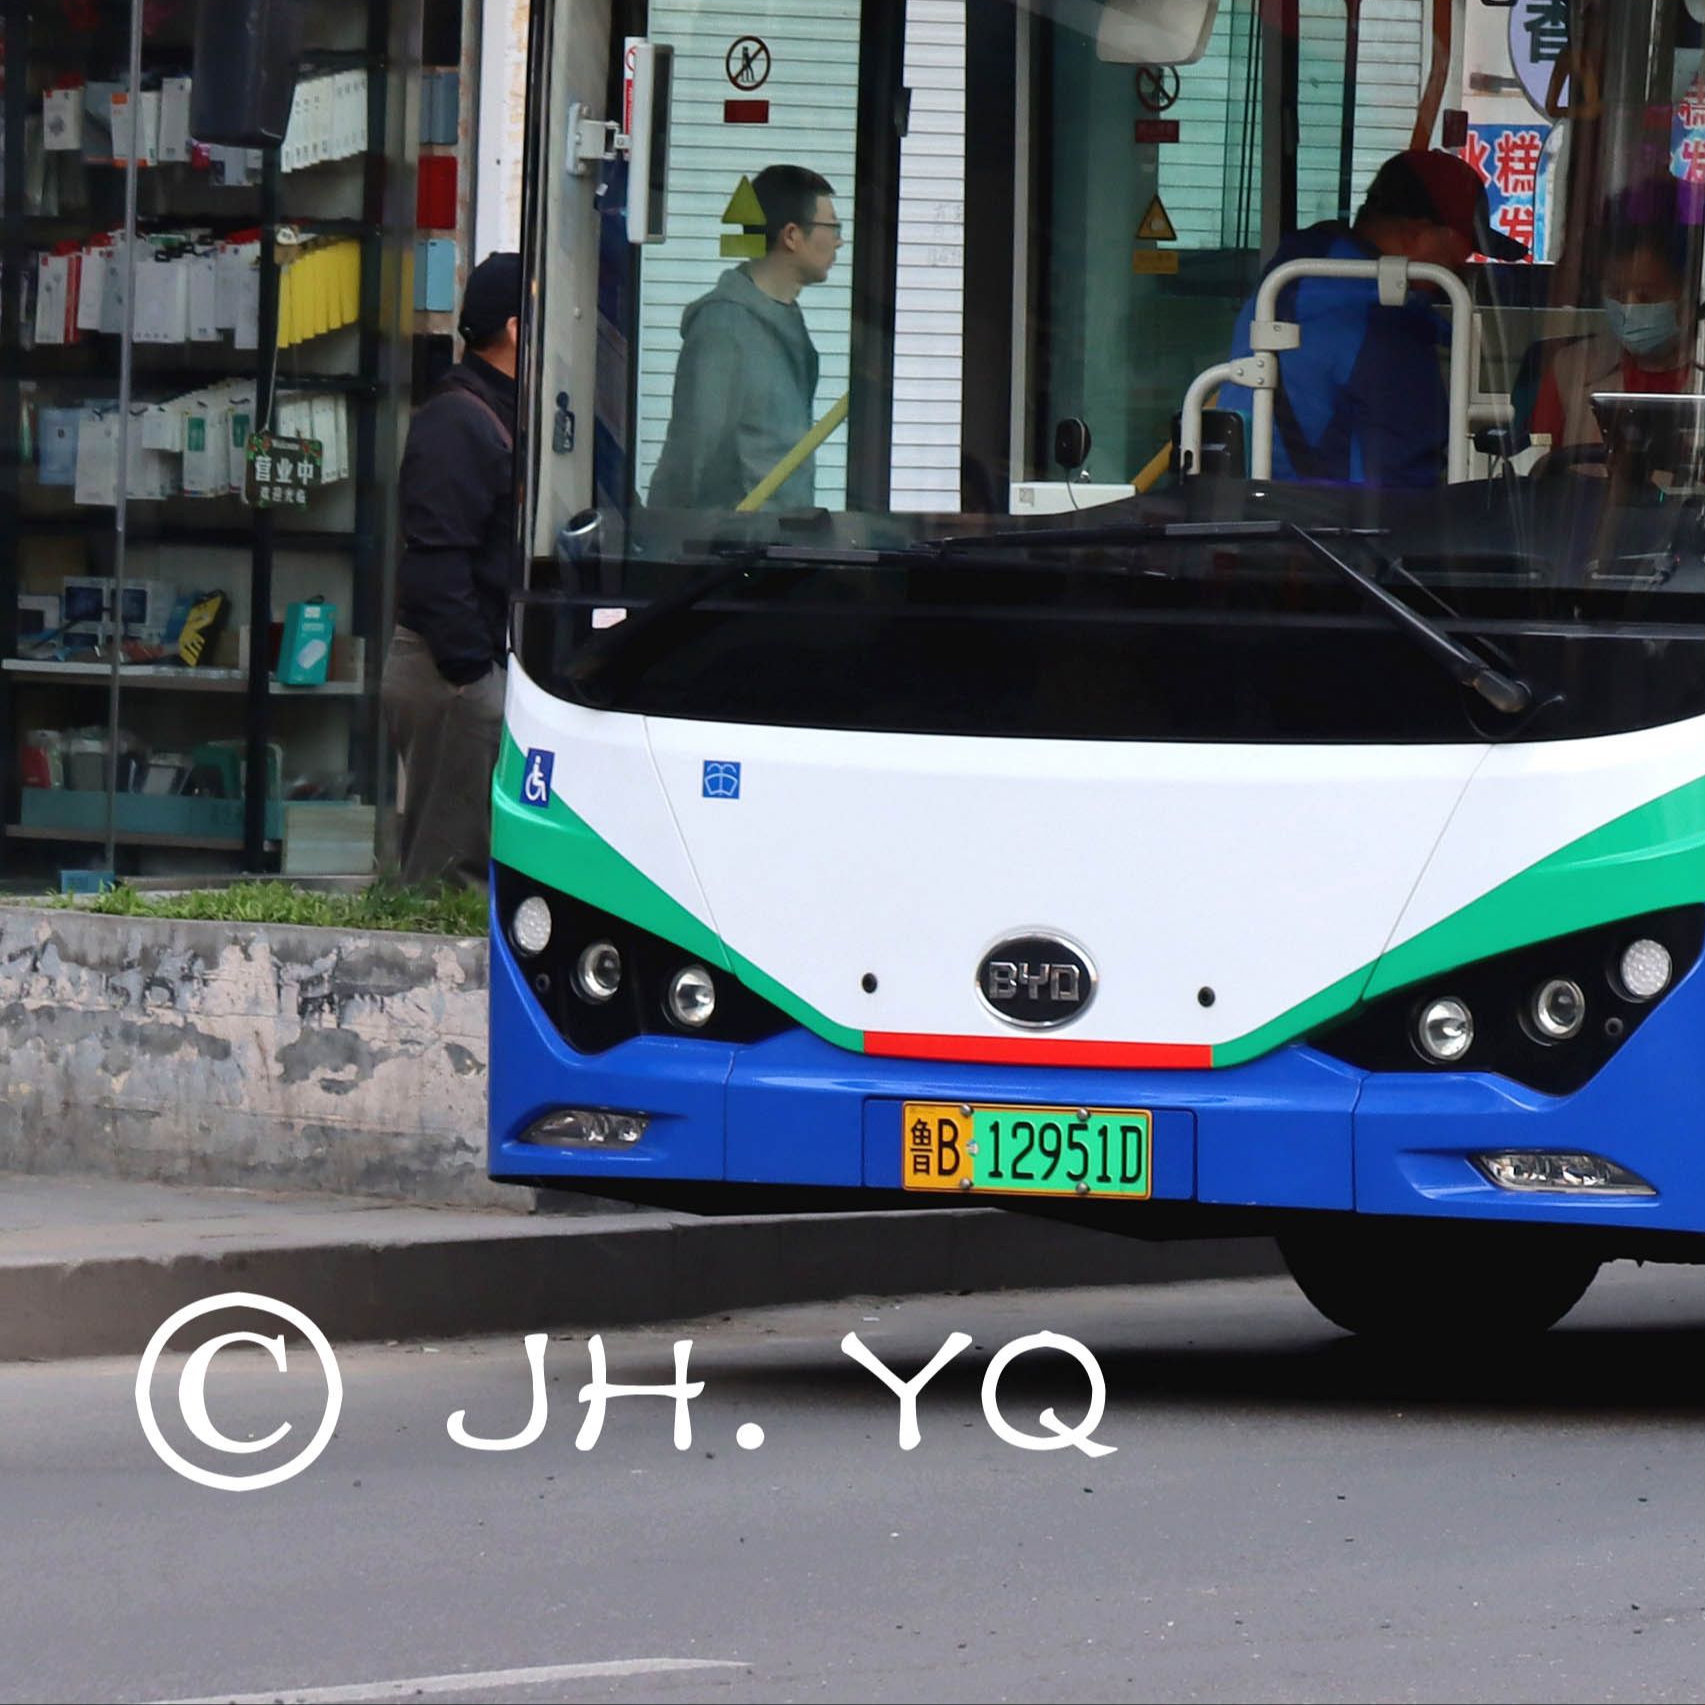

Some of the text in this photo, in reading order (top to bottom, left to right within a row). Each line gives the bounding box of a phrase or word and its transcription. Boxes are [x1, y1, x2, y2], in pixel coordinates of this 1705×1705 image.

[255, 456, 314, 486] 营业中
[988, 960, 1081, 1002] BYD
